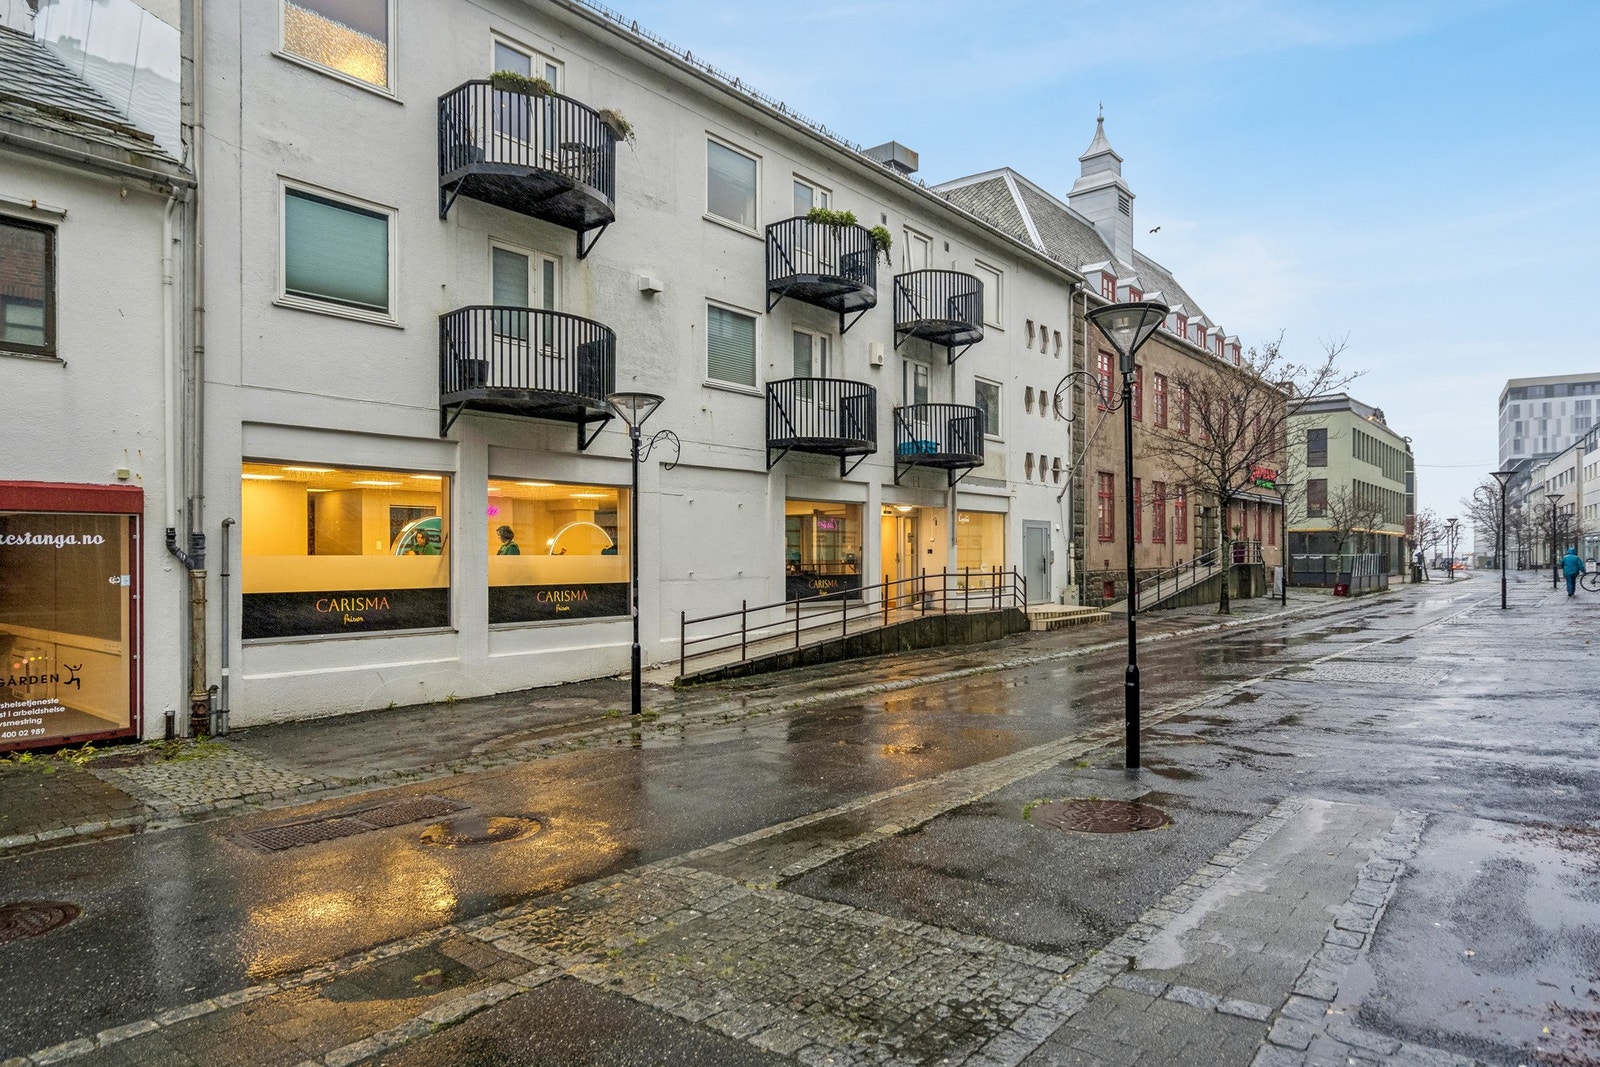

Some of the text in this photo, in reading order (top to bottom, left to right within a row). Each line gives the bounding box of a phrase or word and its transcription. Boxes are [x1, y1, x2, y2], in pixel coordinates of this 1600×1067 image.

[808, 580, 838, 589] CARISMA
[536, 590, 588, 603] CARISMA
[316, 597, 390, 612] CARISMA
[0, 698, 59, 709] shelsetjeneste
[12, 706, 66, 717] arbeidshelse
